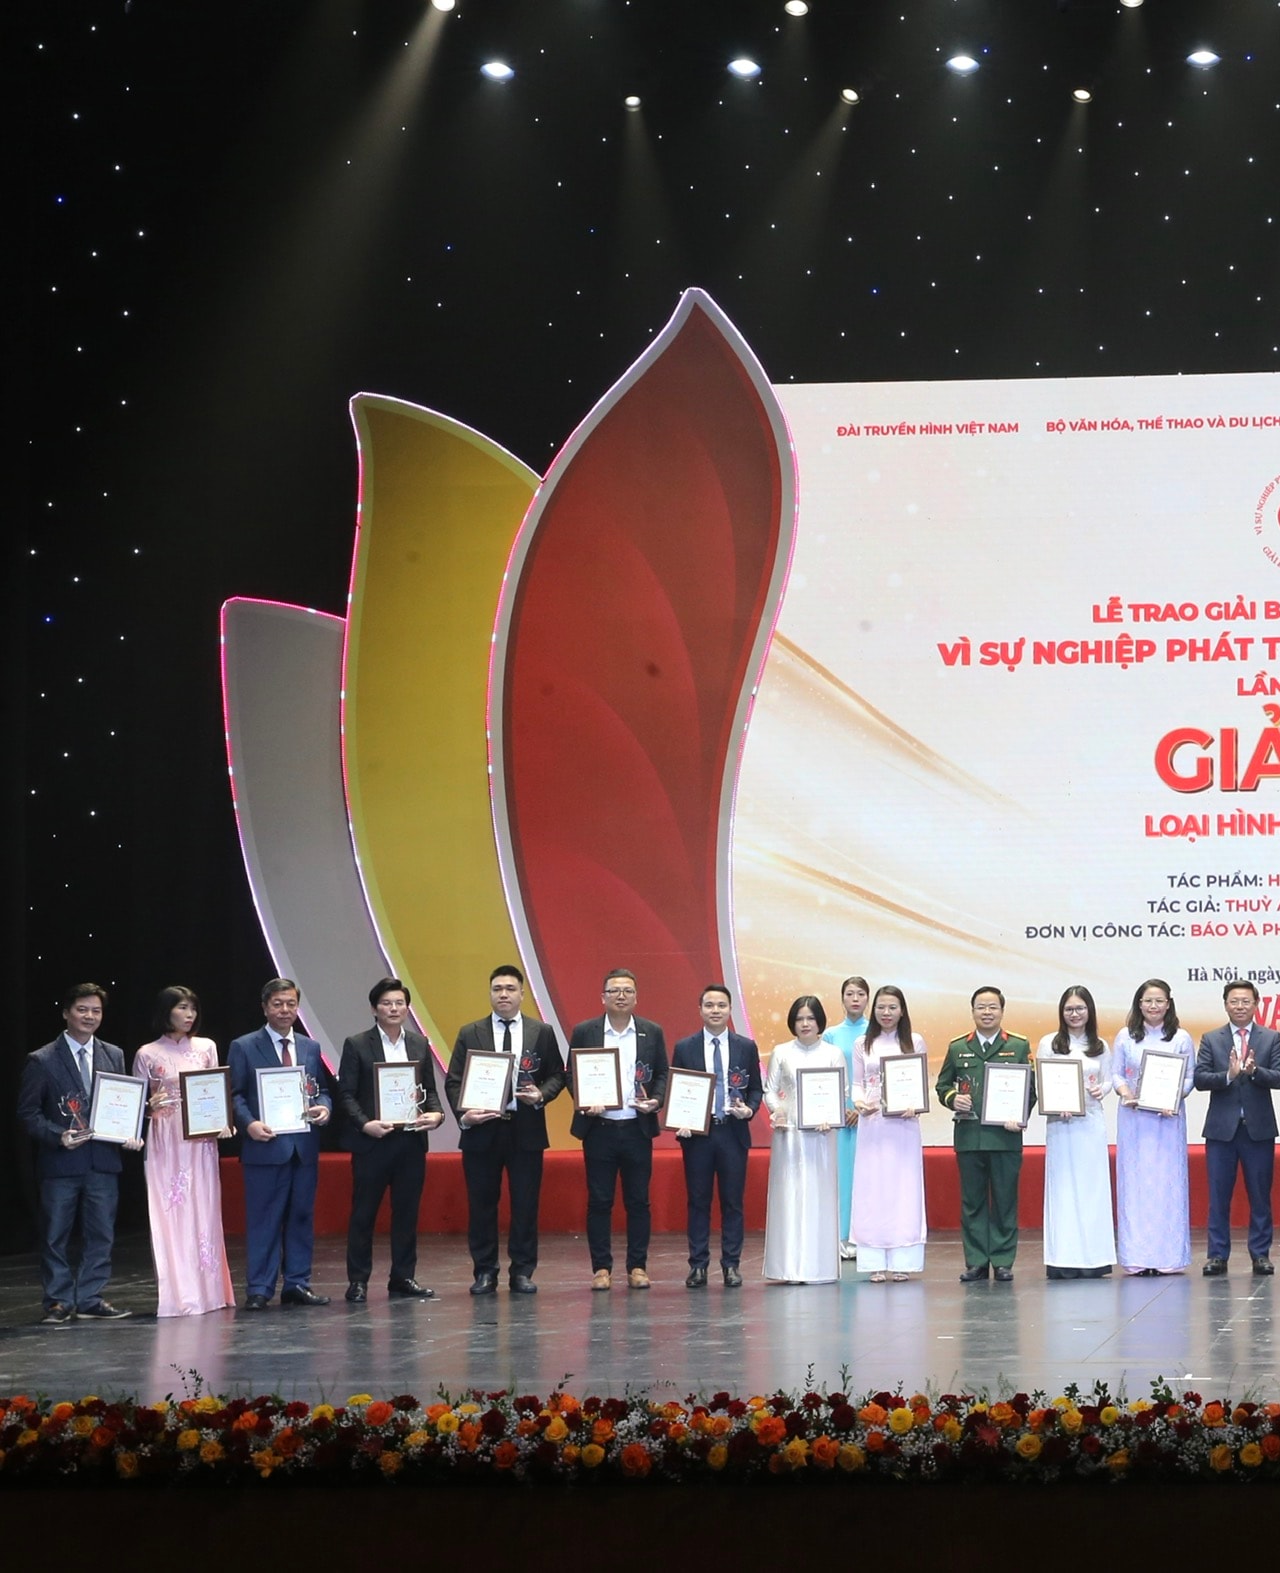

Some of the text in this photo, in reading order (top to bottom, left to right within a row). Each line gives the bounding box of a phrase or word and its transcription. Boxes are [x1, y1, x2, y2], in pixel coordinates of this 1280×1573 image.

[836, 420, 1019, 437] ĐÀI TRUYỀN HÌNH VIỆT NAM
[1045, 418, 1067, 435] BỘ
[1068, 418, 1098, 432] VĂN
[1100, 417, 1135, 433] HÓA,
[1136, 415, 1164, 430] THỂ
[1165, 417, 1205, 430] THAO
[1206, 414, 1227, 429] VÀ
[1228, 416, 1249, 428] DU
[1092, 595, 1124, 624] LỄ
[1127, 602, 1200, 623] TRAO
[1204, 594, 1257, 622] GIẢI
[936, 635, 972, 667] VÌ
[979, 636, 1027, 673] SỰ
[1032, 632, 1157, 670] NGHIỆP
[1166, 630, 1255, 663] PHÁT
[1144, 813, 1210, 844] LOẠI
[1166, 871, 1201, 889] TÁC
[1206, 869, 1264, 888] PHẨM:
[1146, 896, 1181, 914] TÁC
[1185, 894, 1221, 914] GIẢ:
[1224, 894, 1273, 913] THUỲ
[1024, 923, 1065, 939] ĐƠN
[1069, 925, 1087, 942] VỊ
[1091, 921, 1143, 939] CÔNG
[1146, 921, 1186, 938] TÁC:
[1190, 920, 1229, 937] BÁO
[1232, 920, 1258, 937] VÀ
[1187, 968, 1208, 981] Hà
